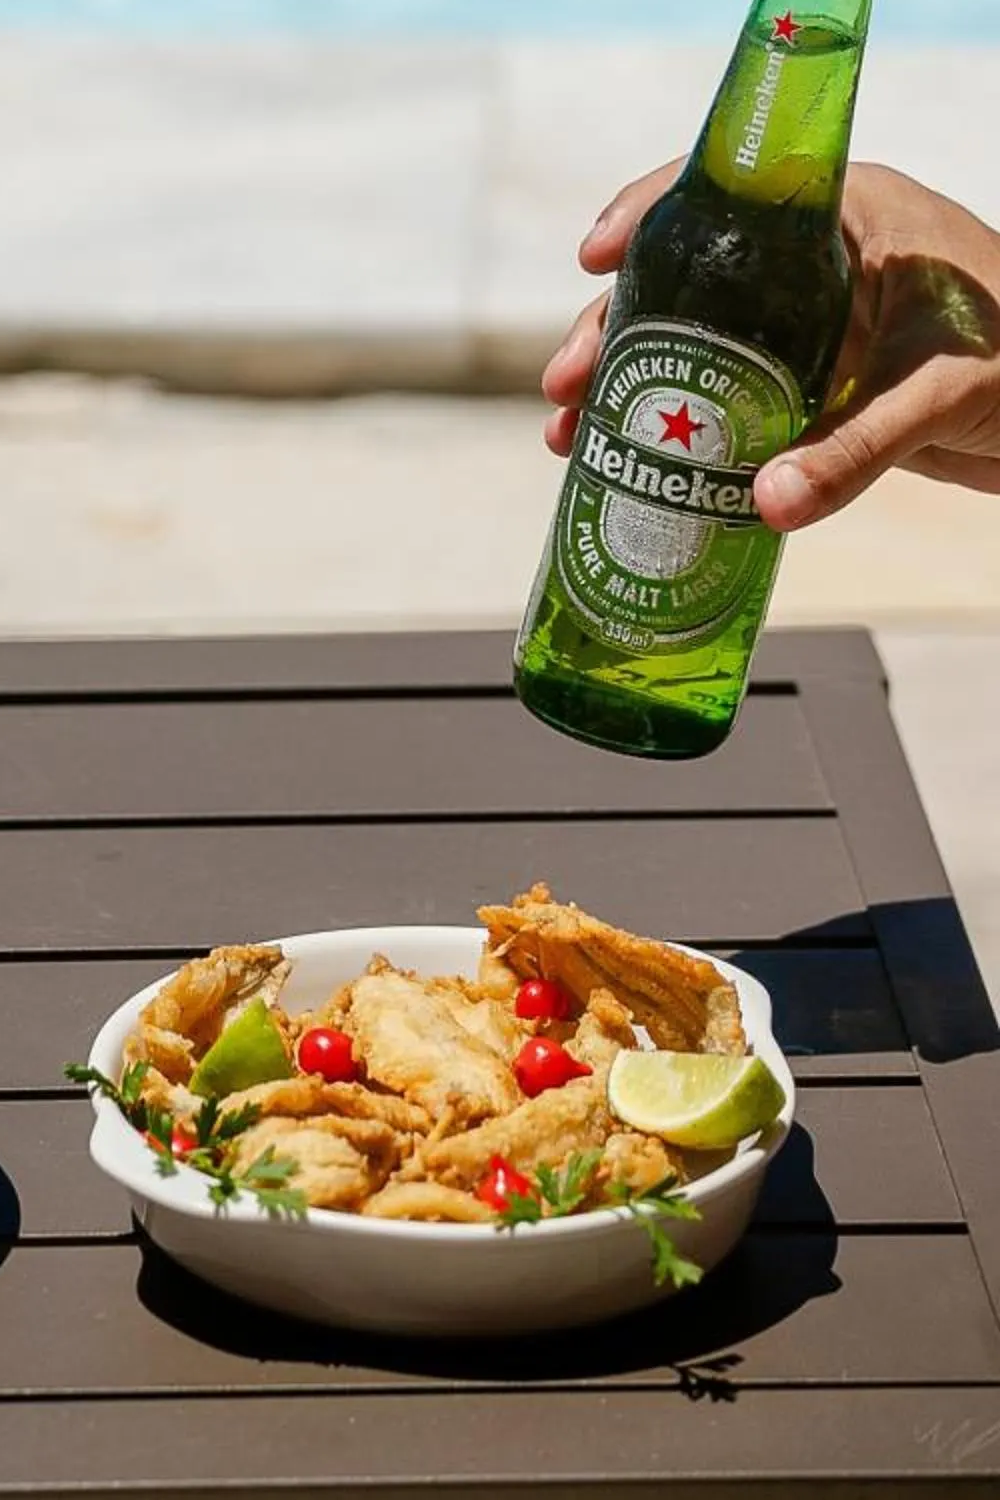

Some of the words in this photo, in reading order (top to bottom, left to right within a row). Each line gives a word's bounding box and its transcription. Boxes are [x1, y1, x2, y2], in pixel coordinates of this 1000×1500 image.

[735, 51, 786, 171] Heineken
[607, 356, 693, 412] HEINEKEN
[577, 521, 606, 579] PURE
[604, 573, 661, 609] MALT
[670, 560, 731, 608] LAGER
